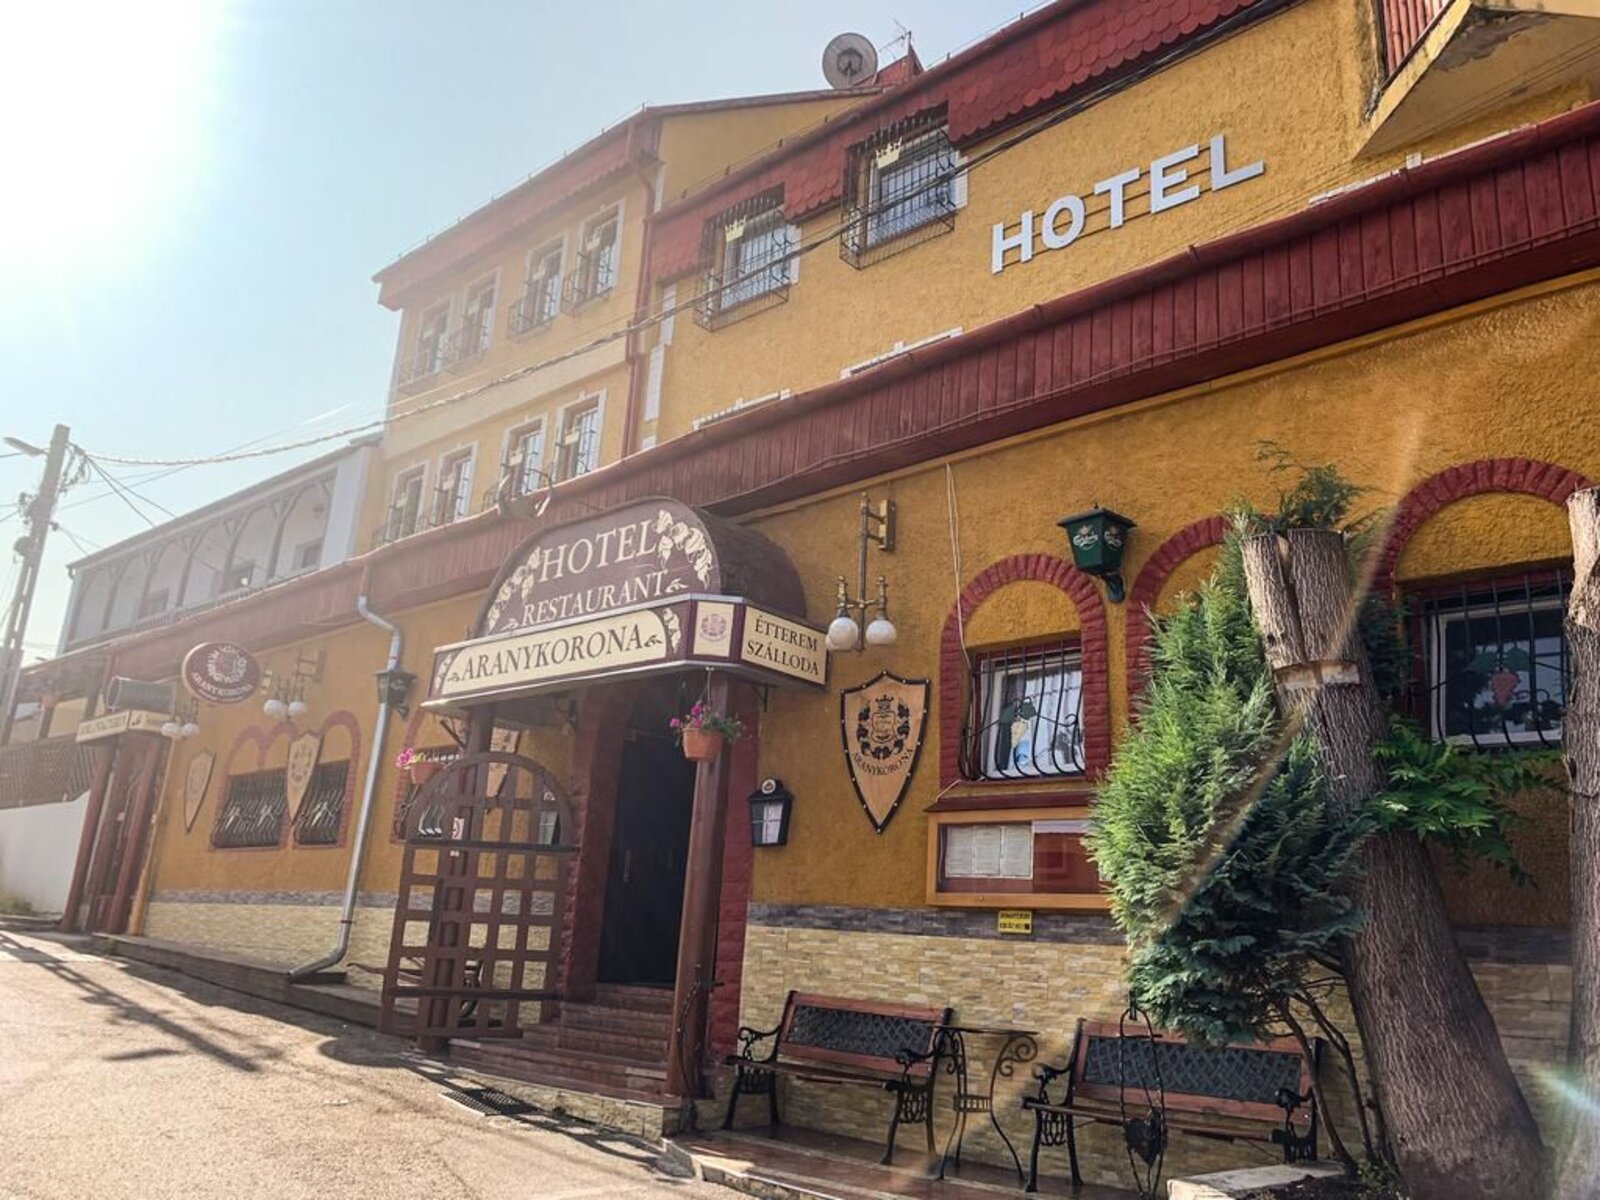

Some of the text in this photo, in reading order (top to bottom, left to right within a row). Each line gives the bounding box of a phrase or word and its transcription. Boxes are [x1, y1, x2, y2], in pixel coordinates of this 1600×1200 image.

[992, 134, 1265, 274] HOTEL
[538, 518, 658, 584] HOTEL
[522, 568, 669, 628] RESTAURANT
[460, 623, 645, 682] ARANYKORONA
[746, 640, 819, 676] SZÁLLODA
[755, 615, 818, 652] ÉTTEREM
